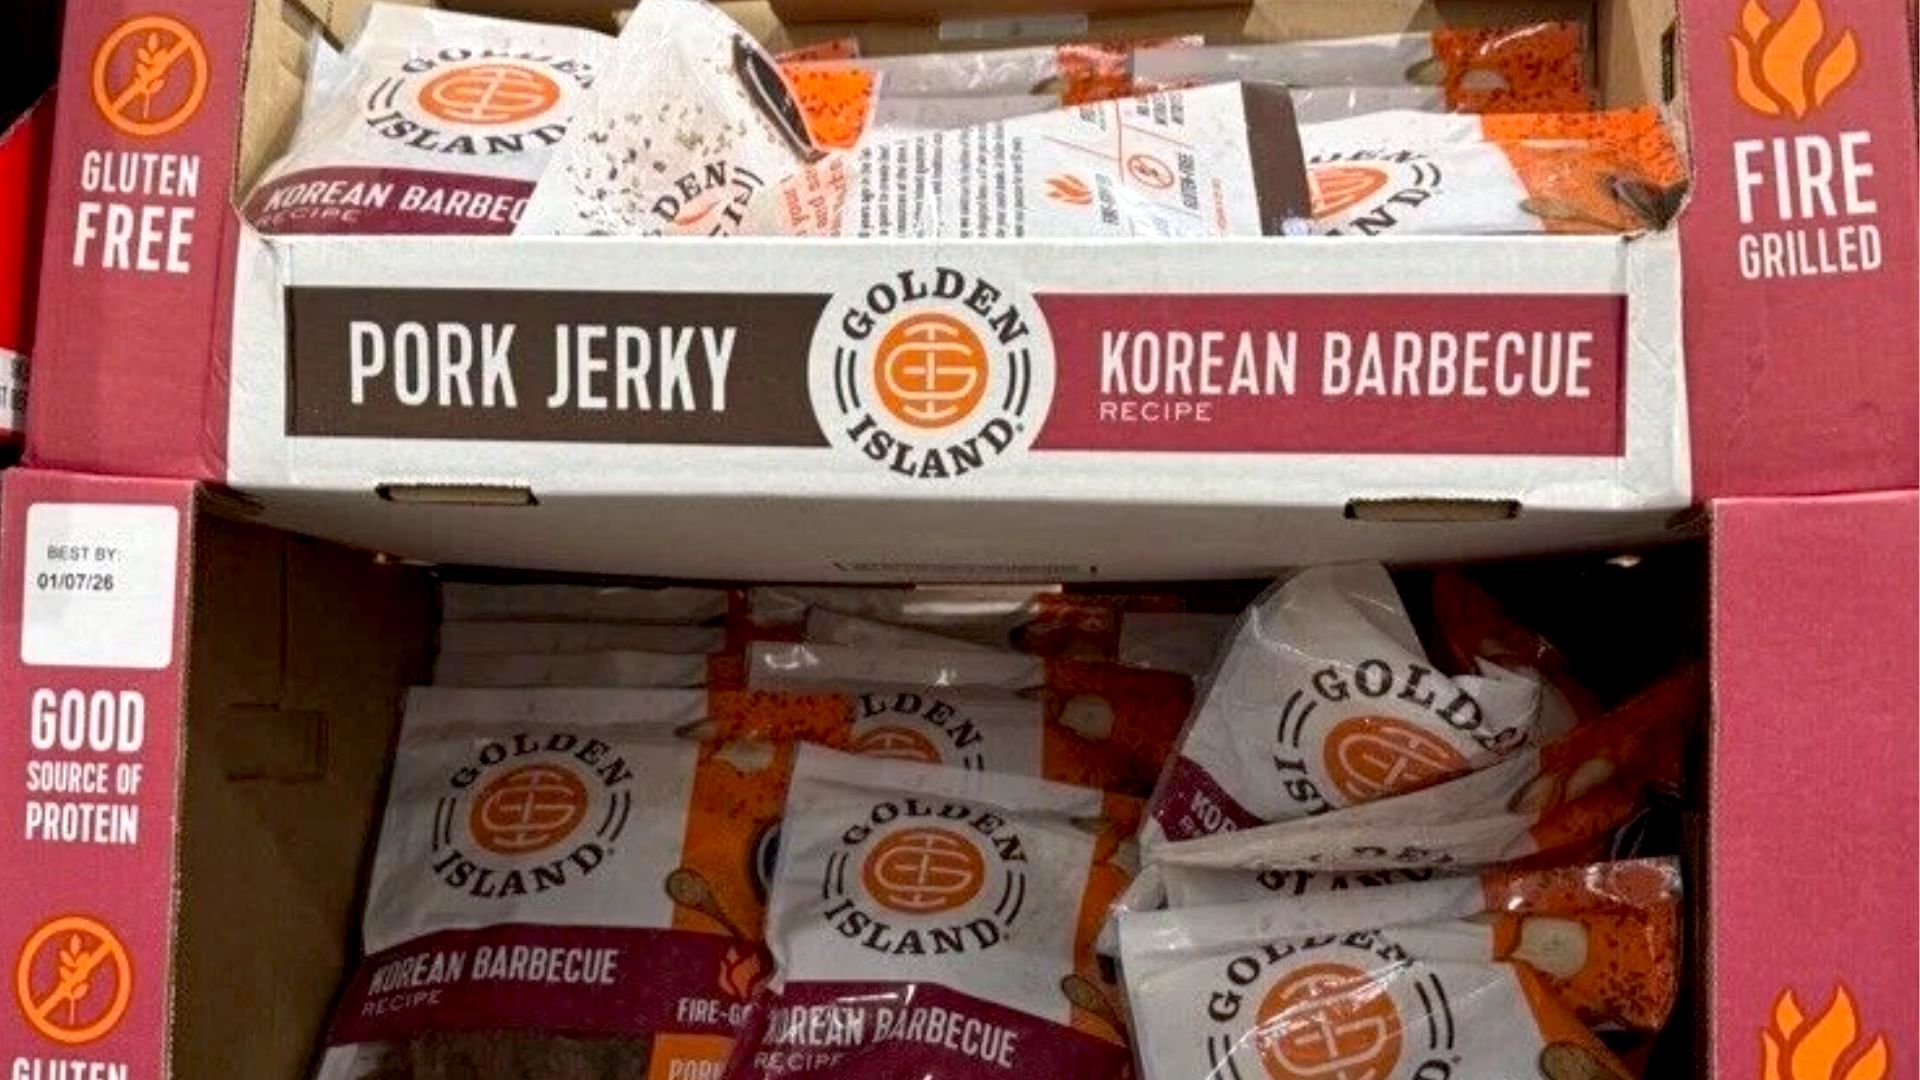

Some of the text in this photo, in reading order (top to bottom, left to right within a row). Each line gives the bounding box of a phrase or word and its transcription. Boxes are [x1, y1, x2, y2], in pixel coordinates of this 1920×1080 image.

[366, 111, 567, 155] ISLAND
[81, 150, 200, 197] GLUTEN
[265, 180, 395, 212] KOREAN
[648, 160, 729, 228] DEN
[1733, 131, 1877, 224] FIRE
[73, 201, 195, 273] FREE
[1739, 224, 1882, 280] GRILLED
[842, 267, 1028, 345] GOLDEN
[350, 320, 737, 412] PORK JERKY
[1100, 331, 1594, 397] KOREAN BARBECUE
[1100, 402, 1212, 421] RECIPE
[847, 412, 1014, 479] ISLAND
[36, 573, 114, 590] 01/07/26
[47, 545, 89, 560] BEST
[31, 688, 145, 752] GOOD
[859, 692, 986, 751] LDEN
[1311, 658, 1512, 752] GOLDE
[26, 760, 143, 795] SOURCE OF
[450, 732, 633, 791] GOLDEN
[25, 801, 139, 845] PROTEIN
[842, 798, 1028, 866] GOLDEN
[433, 841, 606, 898] ISLAND
[823, 899, 1001, 955] ISLAND
[368, 945, 619, 996] KOREAN BARBECUE
[872, 1008, 1017, 1067] BARBECUE
